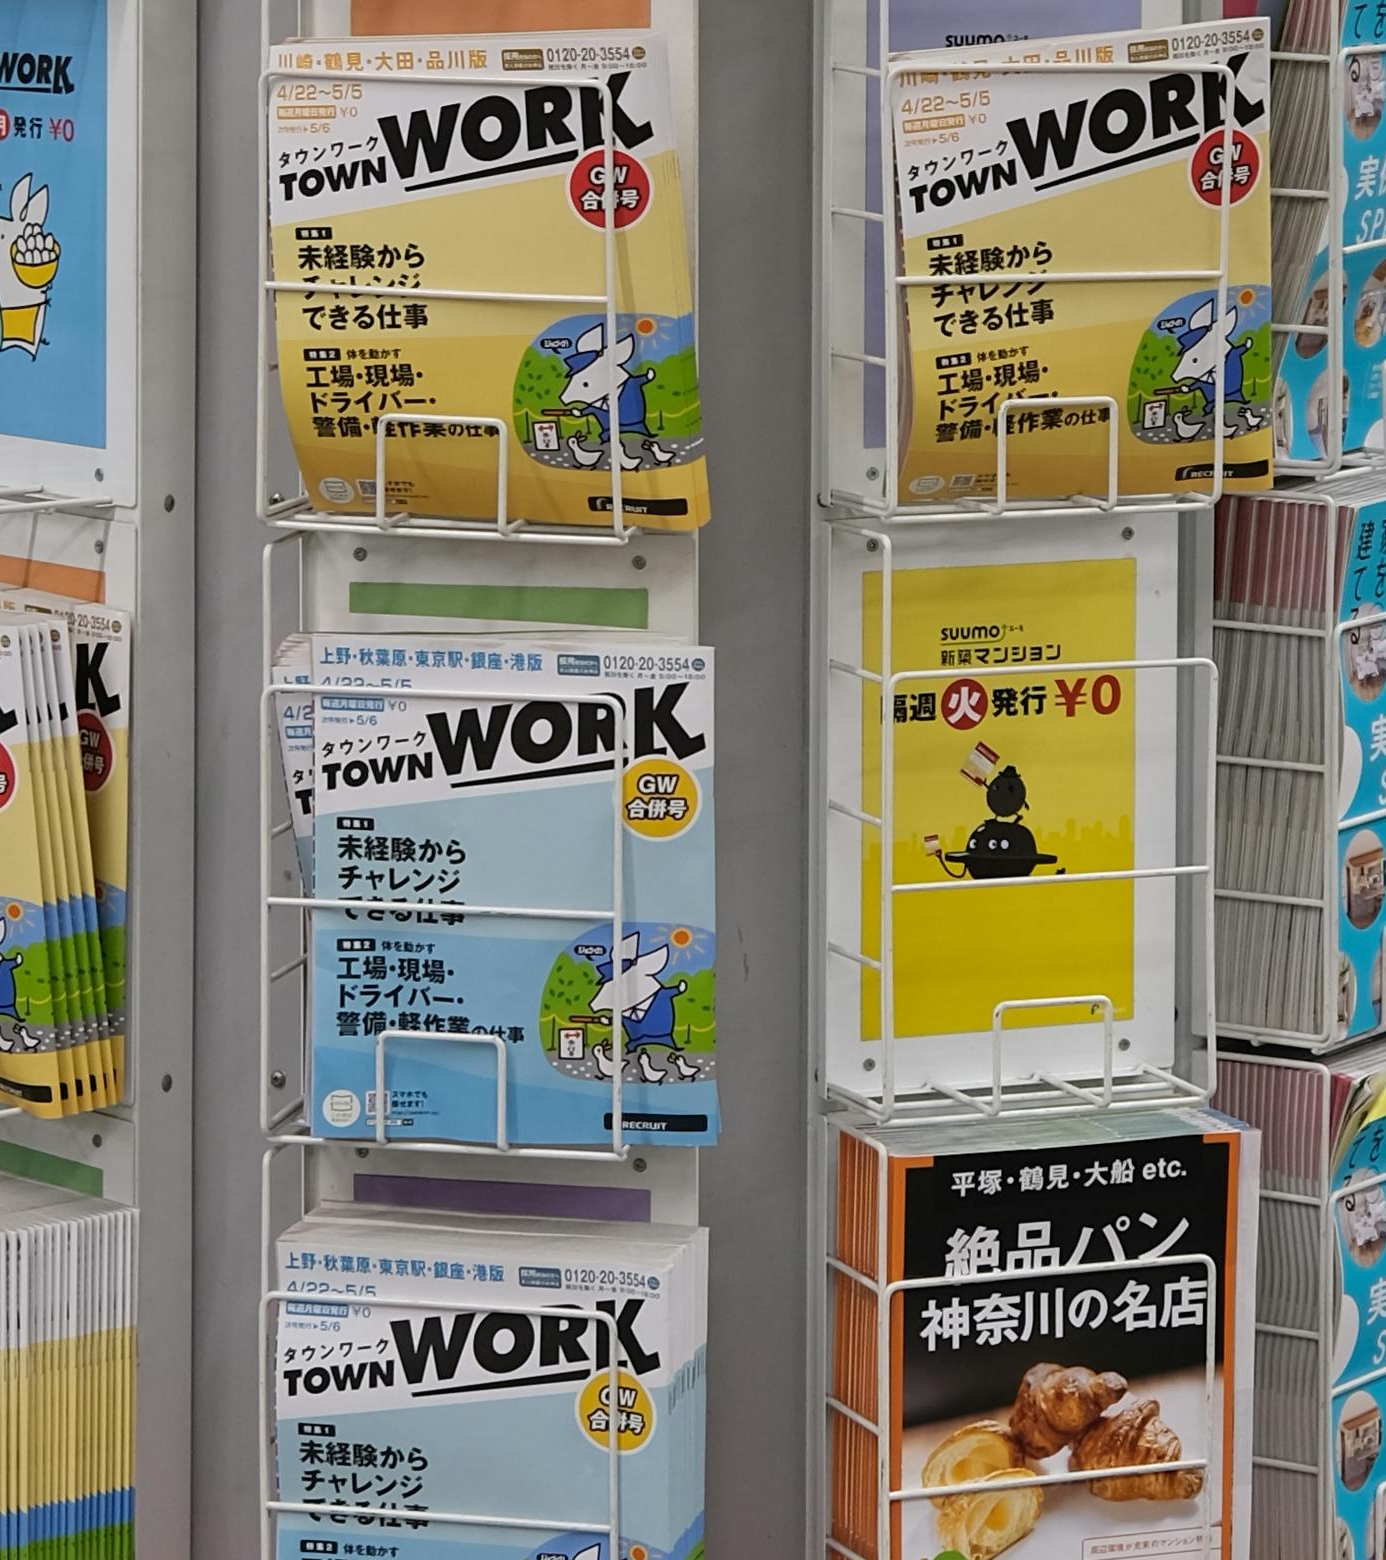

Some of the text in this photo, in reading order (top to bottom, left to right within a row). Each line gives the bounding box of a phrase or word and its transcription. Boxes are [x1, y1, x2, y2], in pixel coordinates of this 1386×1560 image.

[1171, 29, 1250, 52] 0120-20-3554
[278, 50, 488, 71] 川崎・鶴見・大田・品川版
[546, 47, 630, 62] 0120-20-3554
[49, 118, 74, 142] ¥0
[279, 71, 654, 201] TOWN WORK
[909, 52, 1265, 213] TOWN WORK
[278, 134, 379, 167] タウンワーク
[907, 139, 1008, 181] タウンワーク
[298, 243, 426, 270] 未経験から
[929, 241, 1053, 276] 未経験から
[302, 303, 429, 330] できる仕事
[935, 299, 1054, 337] できる仕事
[306, 364, 424, 388] 工場・現場・
[936, 361, 1049, 395] 工場・現場・
[310, 391, 437, 415] ドライバー・
[941, 624, 1000, 641] suumo
[319, 645, 543, 672] 上野・秋葉原・東京駅・銀座・港版
[604, 655, 690, 672] 0120-20-3554
[941, 644, 1061, 666] 新築マンション
[1053, 673, 1121, 717] ¥0
[357, 714, 377, 726] 5/6
[322, 682, 706, 791] TOWN WORK
[322, 731, 426, 758] タウンワーク
[638, 774, 678, 794] GW
[627, 797, 687, 819] 合併号
[337, 835, 467, 864] 未経験から
[338, 866, 460, 894] チャレンジ
[381, 940, 436, 954] 体を動かす
[337, 956, 454, 983] 工場・現場・
[338, 984, 464, 1008] ドライバー・
[622, 1119, 667, 1131] RECRUIT
[951, 1158, 1187, 1197] 平塚・鶴見・大船 etc.
[944, 1212, 1189, 1285] 絶品パン
[285, 1251, 504, 1282] 上野・秋葉原・東京駅・銀座・港版
[565, 1269, 645, 1288] 0120-20-3554
[920, 1276, 1208, 1352] 神奈川の名店
[283, 1298, 660, 1396] TOWN WORK
[283, 1337, 388, 1363] タウンワーク
[300, 1440, 429, 1471] 未経験から
[302, 1469, 423, 1497] チャレンジ
